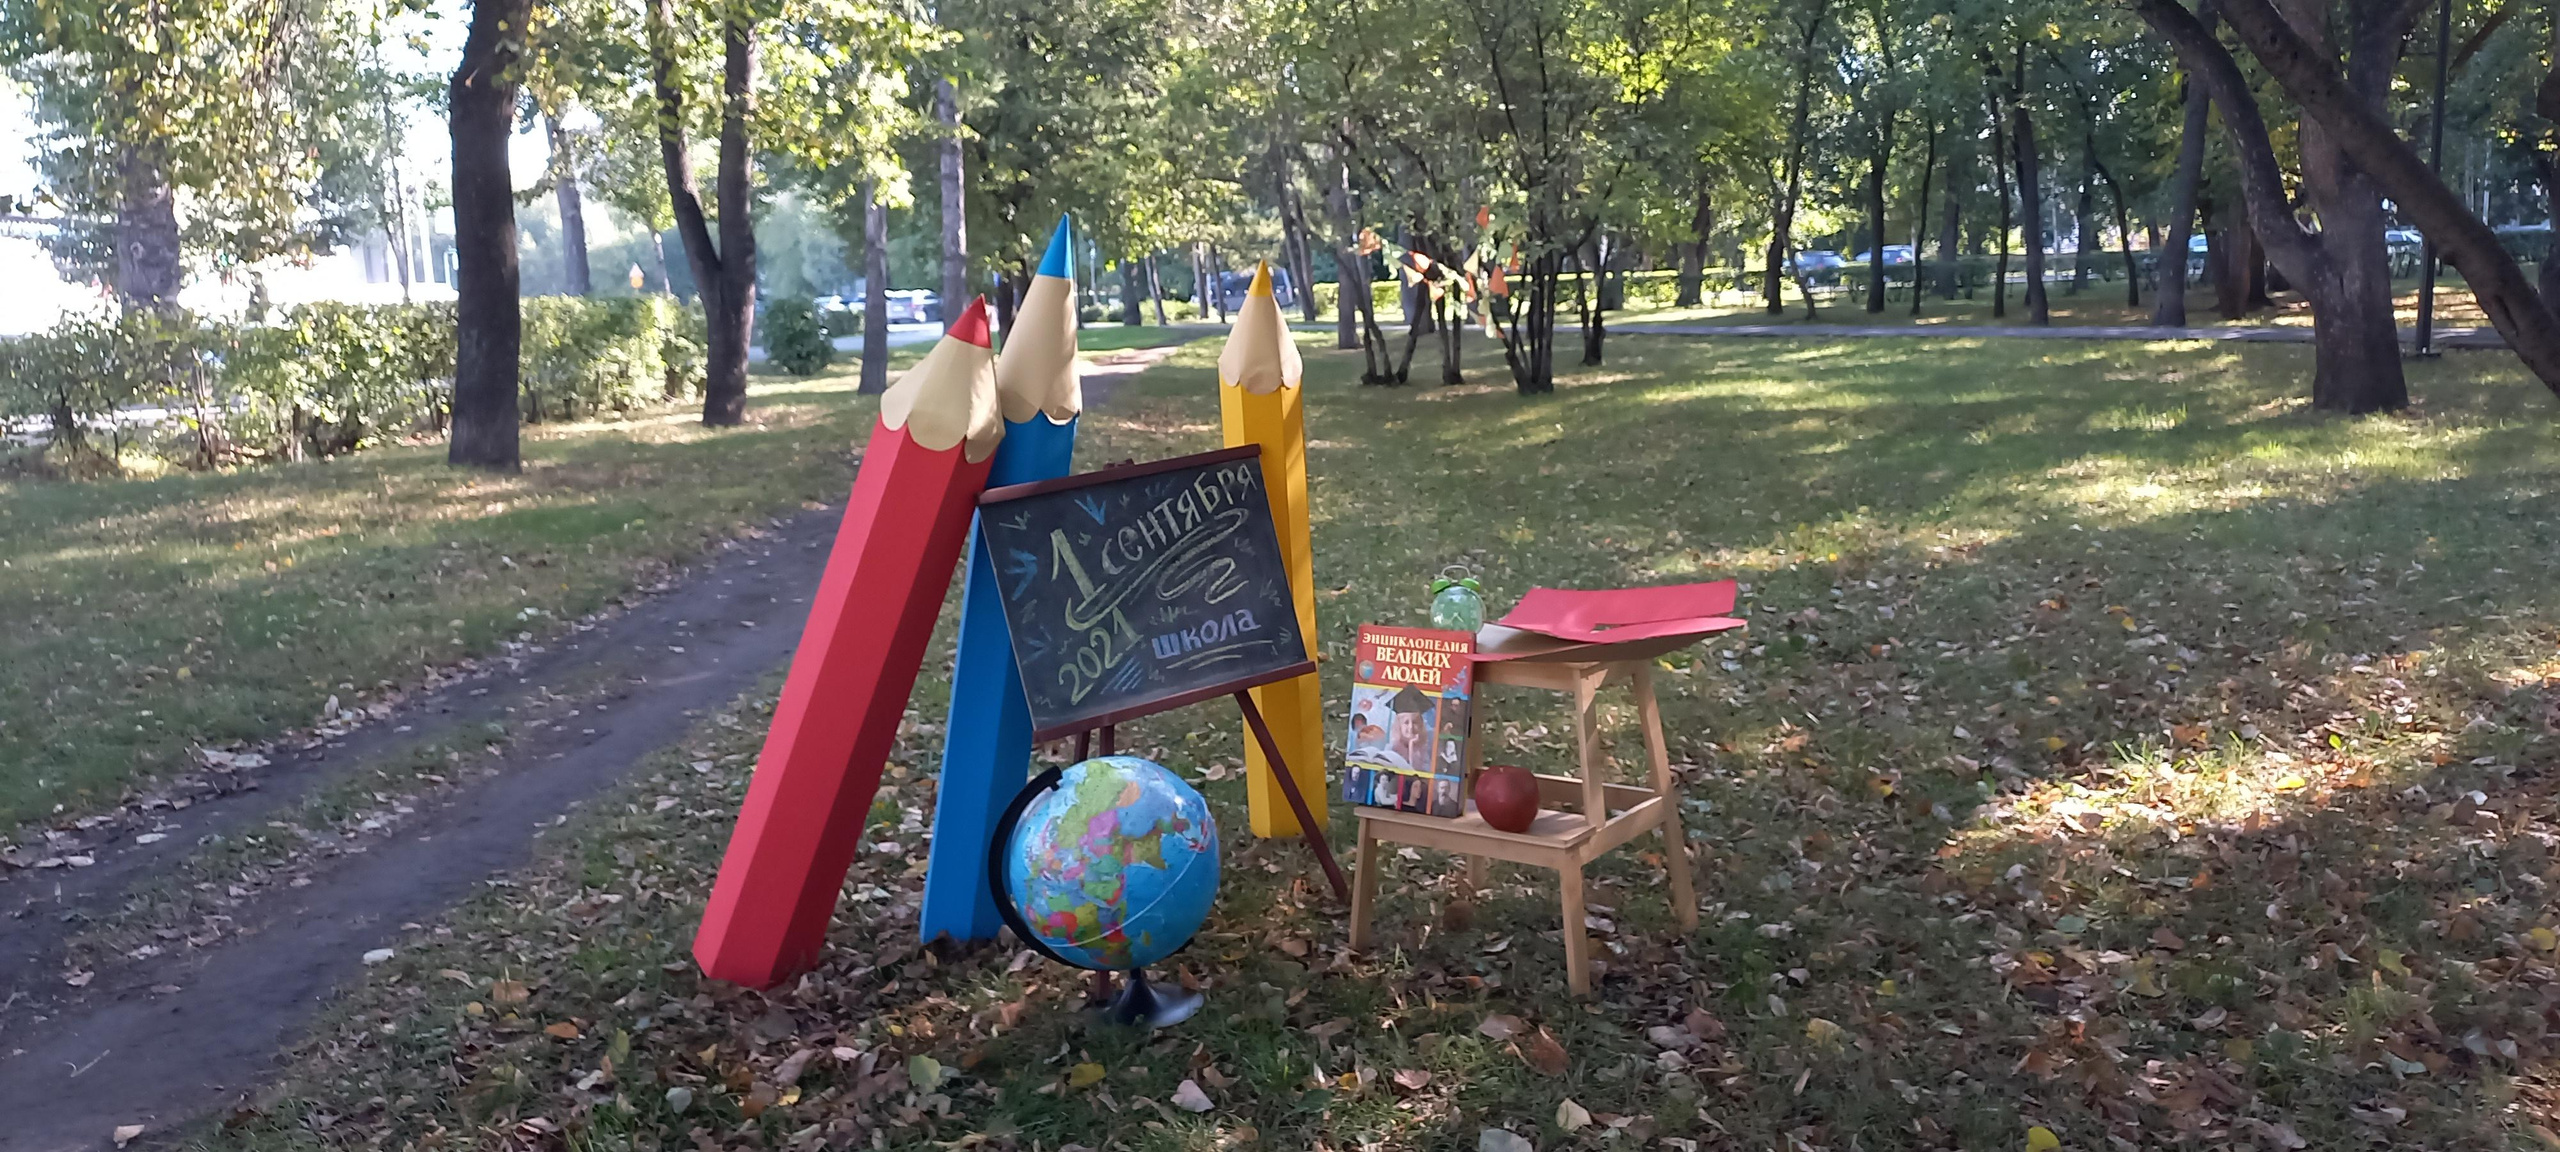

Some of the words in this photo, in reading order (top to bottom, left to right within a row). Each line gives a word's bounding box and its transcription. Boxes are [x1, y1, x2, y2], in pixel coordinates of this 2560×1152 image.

[1050, 528, 1108, 613] 1
[1058, 603, 1144, 706] 2021
[1362, 632, 1469, 654] ЭНЦИКЛОПЕДИЯ
[1375, 645, 1452, 669] ВЕЛИКИХ
[1381, 664, 1442, 686] ЛЮДЕЙ
